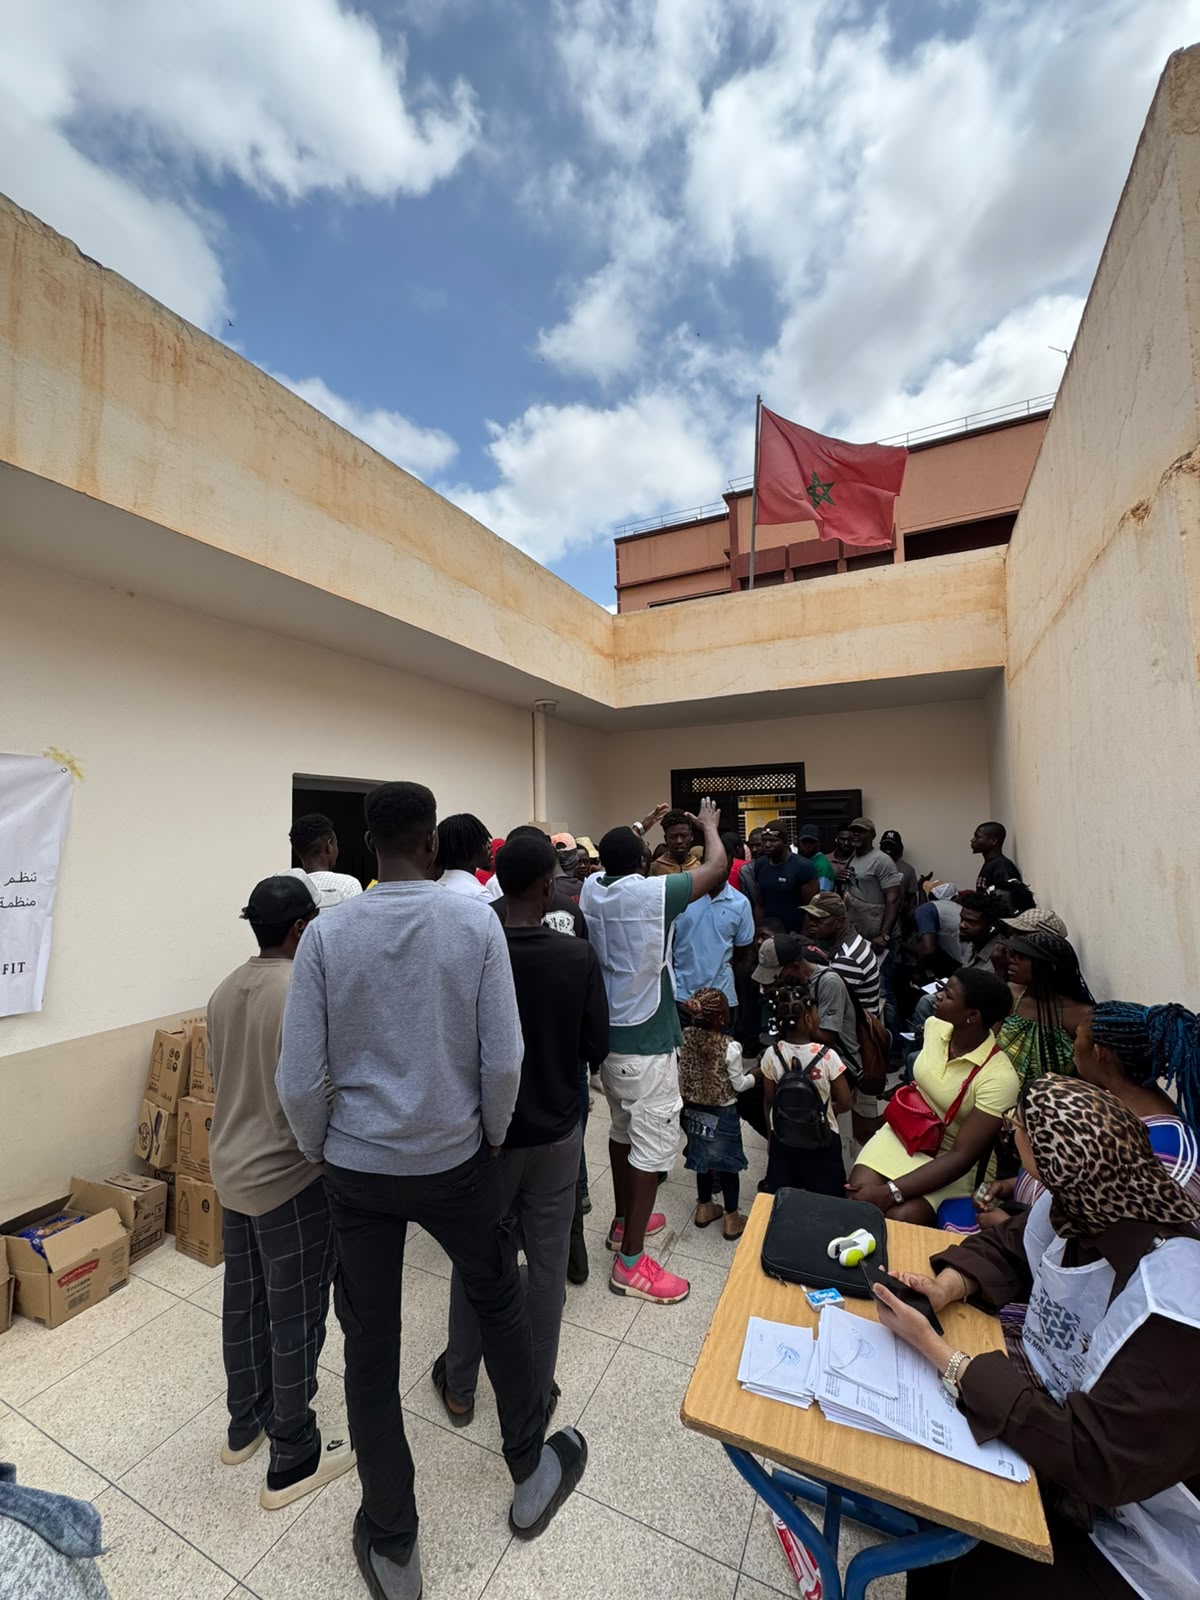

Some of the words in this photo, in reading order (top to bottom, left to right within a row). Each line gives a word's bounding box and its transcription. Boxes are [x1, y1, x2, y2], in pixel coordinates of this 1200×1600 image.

[3, 871, 37, 886] تنظم
[0, 896, 36, 909] منظمة
[2, 961, 26, 975] FIT
